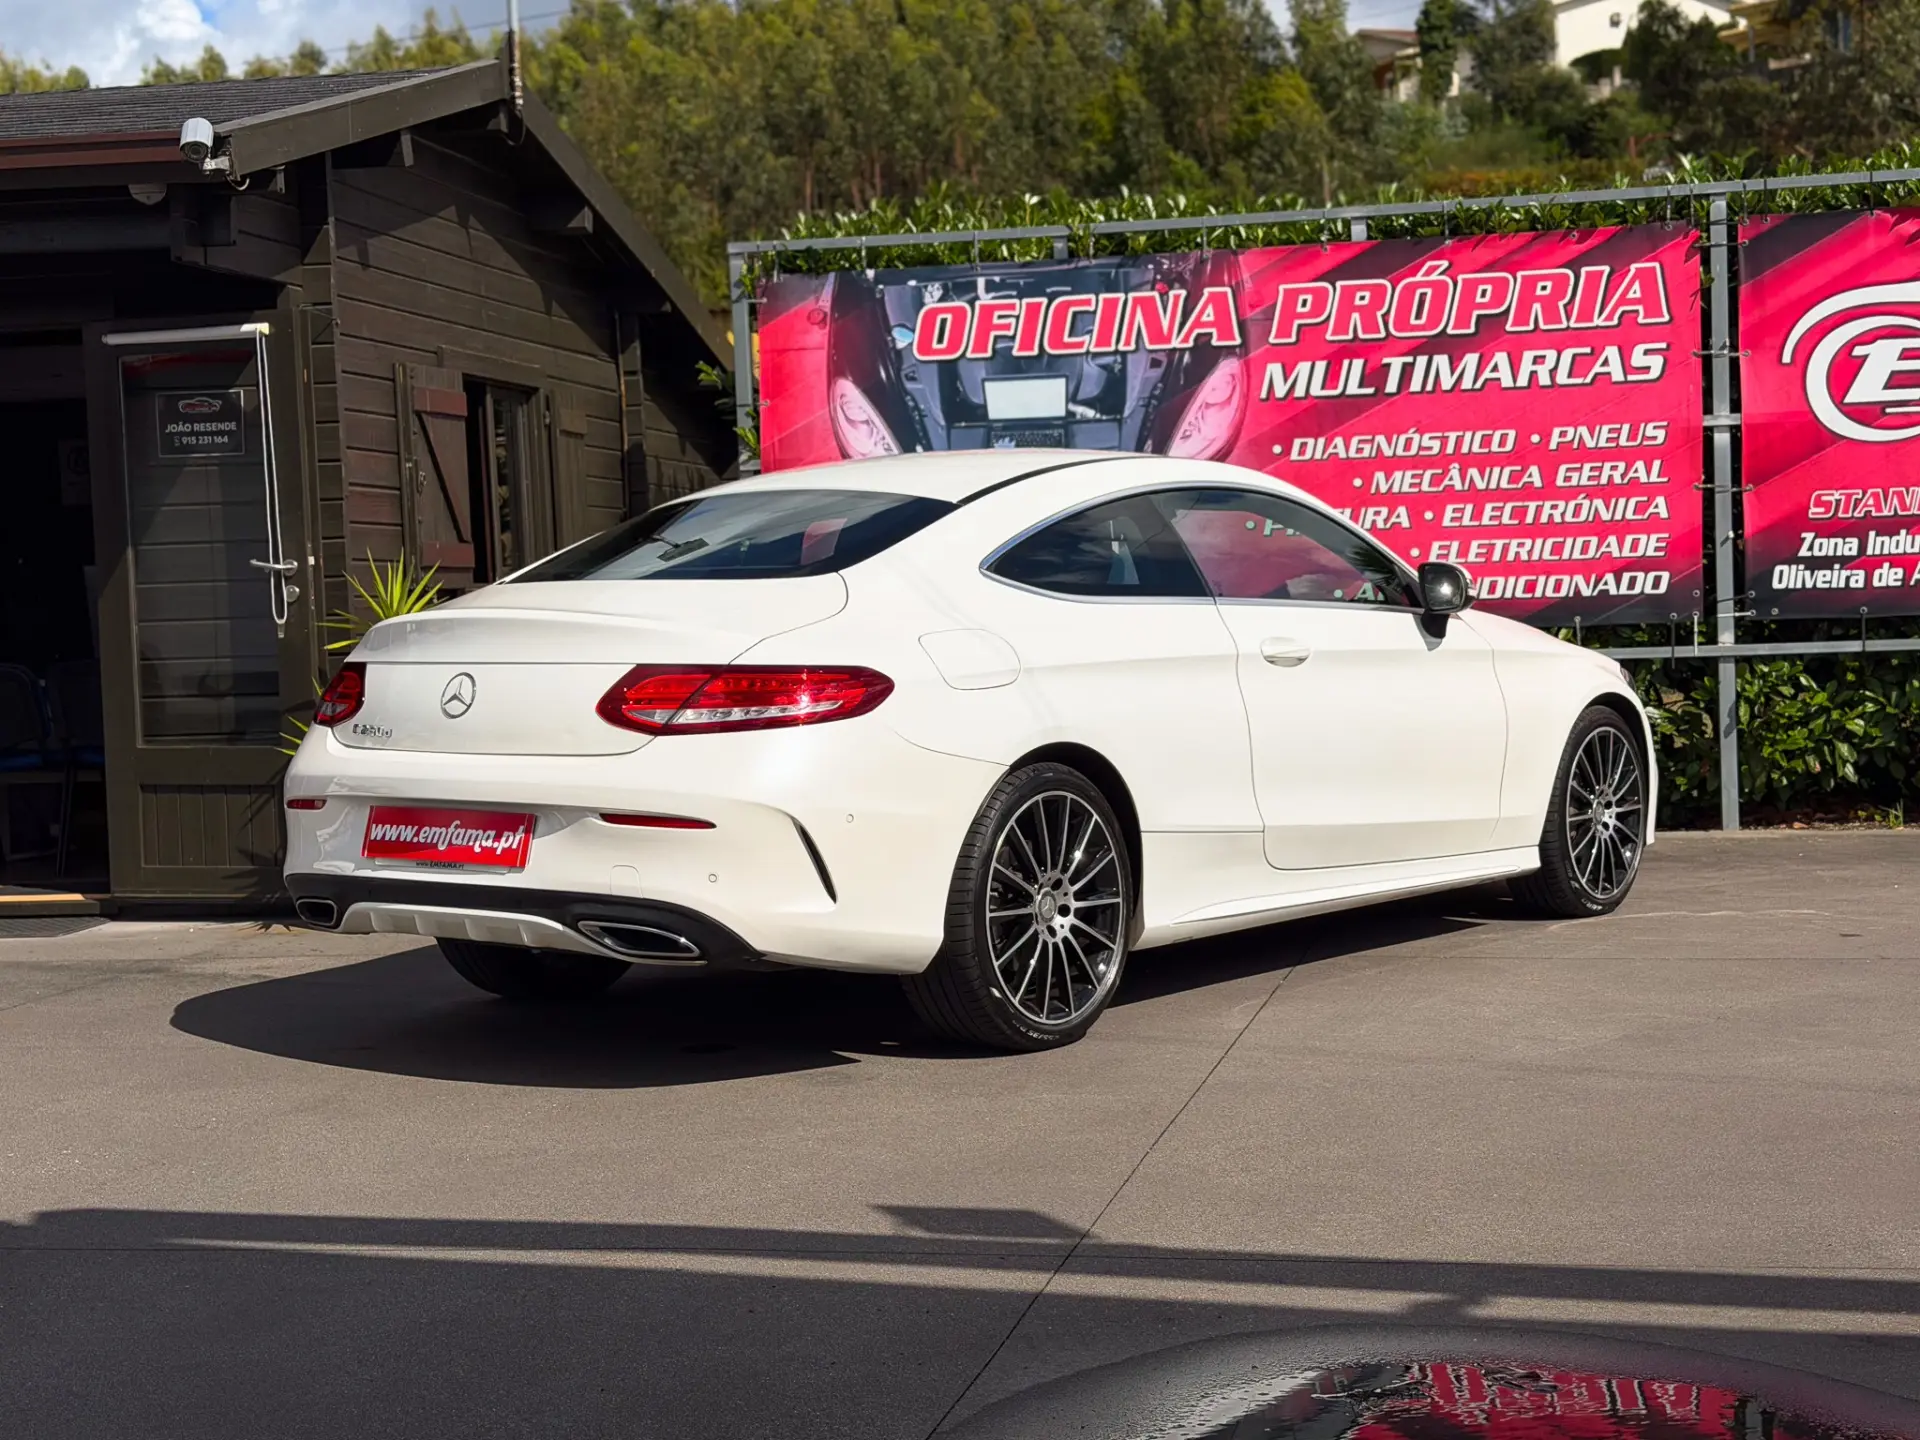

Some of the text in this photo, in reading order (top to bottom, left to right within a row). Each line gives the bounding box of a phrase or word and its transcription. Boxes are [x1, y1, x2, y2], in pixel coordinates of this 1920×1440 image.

[912, 260, 1670, 361] OFICINA PRÓPRIA
[1259, 342, 1668, 400] MULTIMARCAS
[165, 421, 237, 433] JOÃO RESENDE
[181, 434, 228, 445] 915 231 164
[1290, 422, 1668, 461] DIAGNÓSTICO PNEUS
[1370, 459, 1669, 494] MECÂNICA GERAL
[1441, 494, 1669, 528] ELECTRÓNICA
[1808, 486, 1920, 519] STAN
[1428, 533, 1669, 564] ELETRICIDADE
[1797, 531, 1859, 557] Zona
[1771, 563, 1866, 590] Oliveira
[1872, 561, 1904, 588] de
[370, 820, 525, 855] www.emfama.pt
